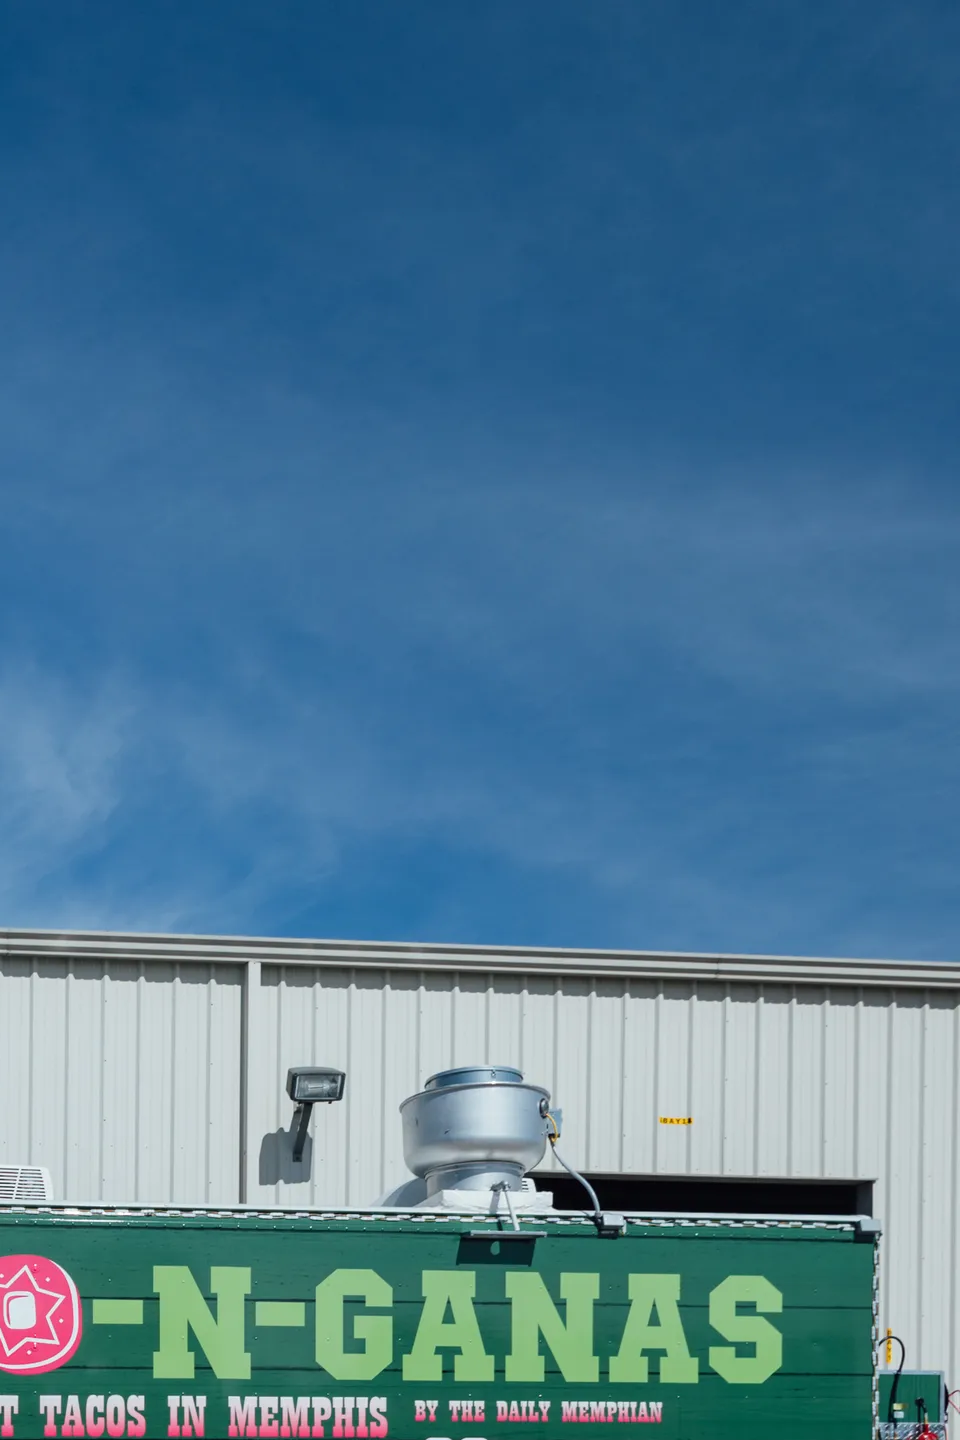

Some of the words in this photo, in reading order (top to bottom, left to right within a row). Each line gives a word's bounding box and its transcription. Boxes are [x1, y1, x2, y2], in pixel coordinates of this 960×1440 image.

[40, 1395, 147, 1439] TACOS
[168, 1396, 207, 1439] IN
[228, 1396, 389, 1440] MEMPHIS
[415, 1400, 440, 1423] BY
[449, 1401, 486, 1423] THE
[497, 1401, 552, 1424] DAILY
[562, 1401, 664, 1424] MEMPHIAN
